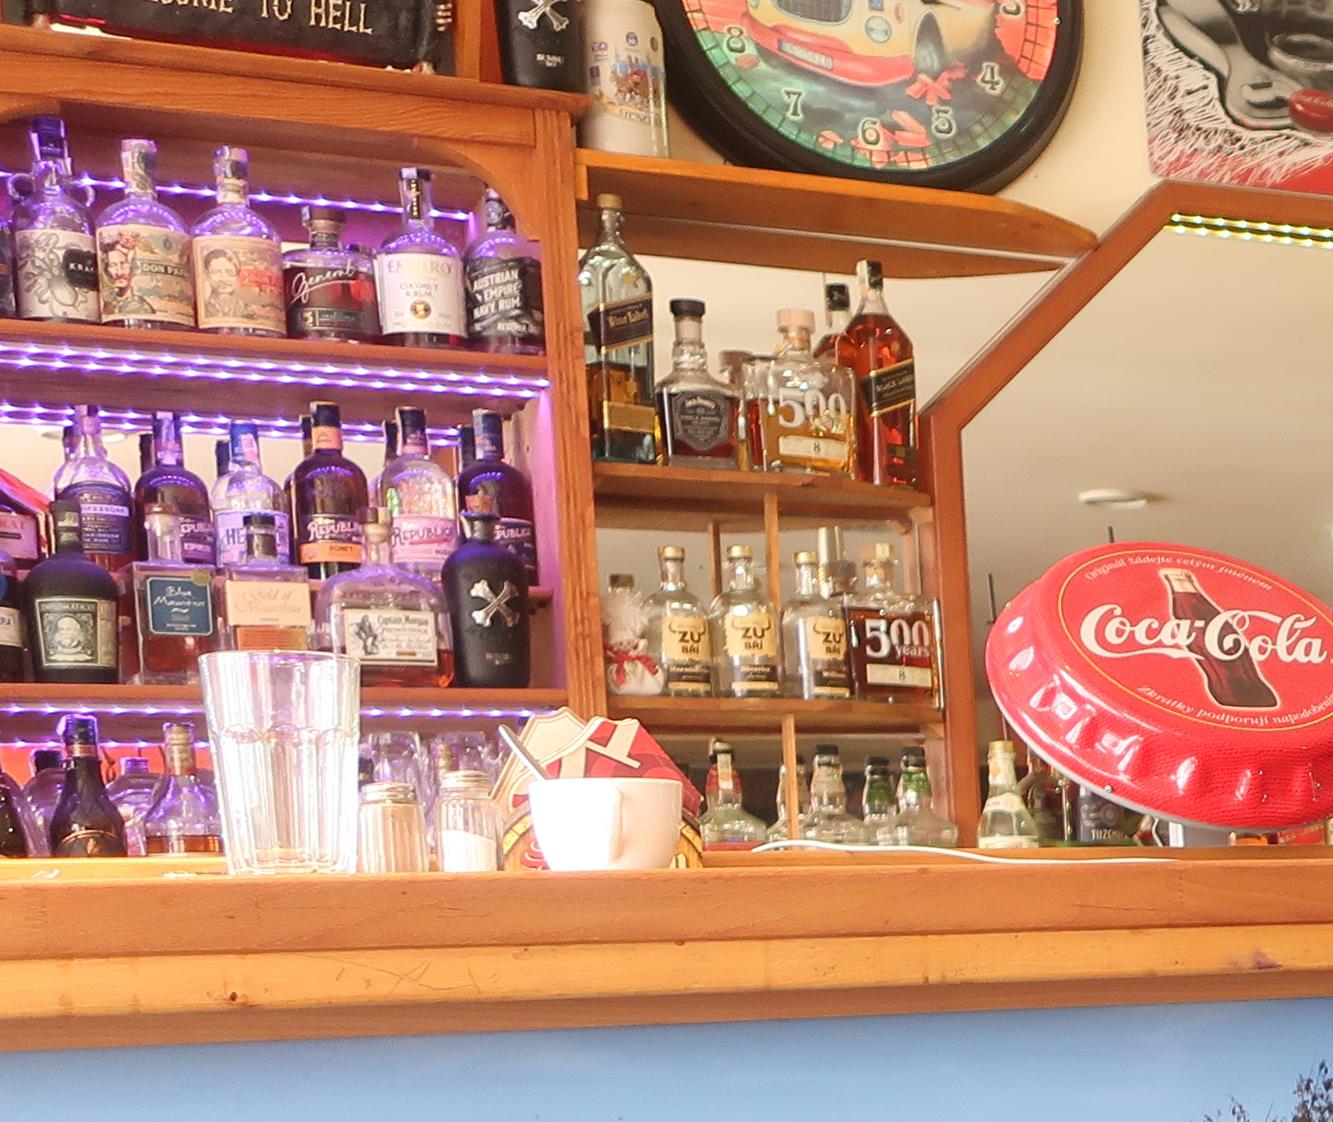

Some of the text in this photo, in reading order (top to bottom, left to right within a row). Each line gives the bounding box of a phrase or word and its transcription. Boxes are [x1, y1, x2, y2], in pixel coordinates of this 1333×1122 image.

[309, 0, 374, 34] HELL
[726, 26, 746, 53] 8
[979, 62, 1002, 91] 4
[784, 91, 803, 119] 7
[859, 118, 881, 147] 6
[933, 107, 956, 135] 5
[474, 269, 519, 291] AUSTRIAN
[485, 283, 520, 299] EMPIRE
[474, 302, 496, 319] NAVY
[779, 386, 846, 428] 500
[865, 616, 931, 658] 500
[1080, 603, 1328, 664] Coca-Cola
[895, 643, 931, 659] years
